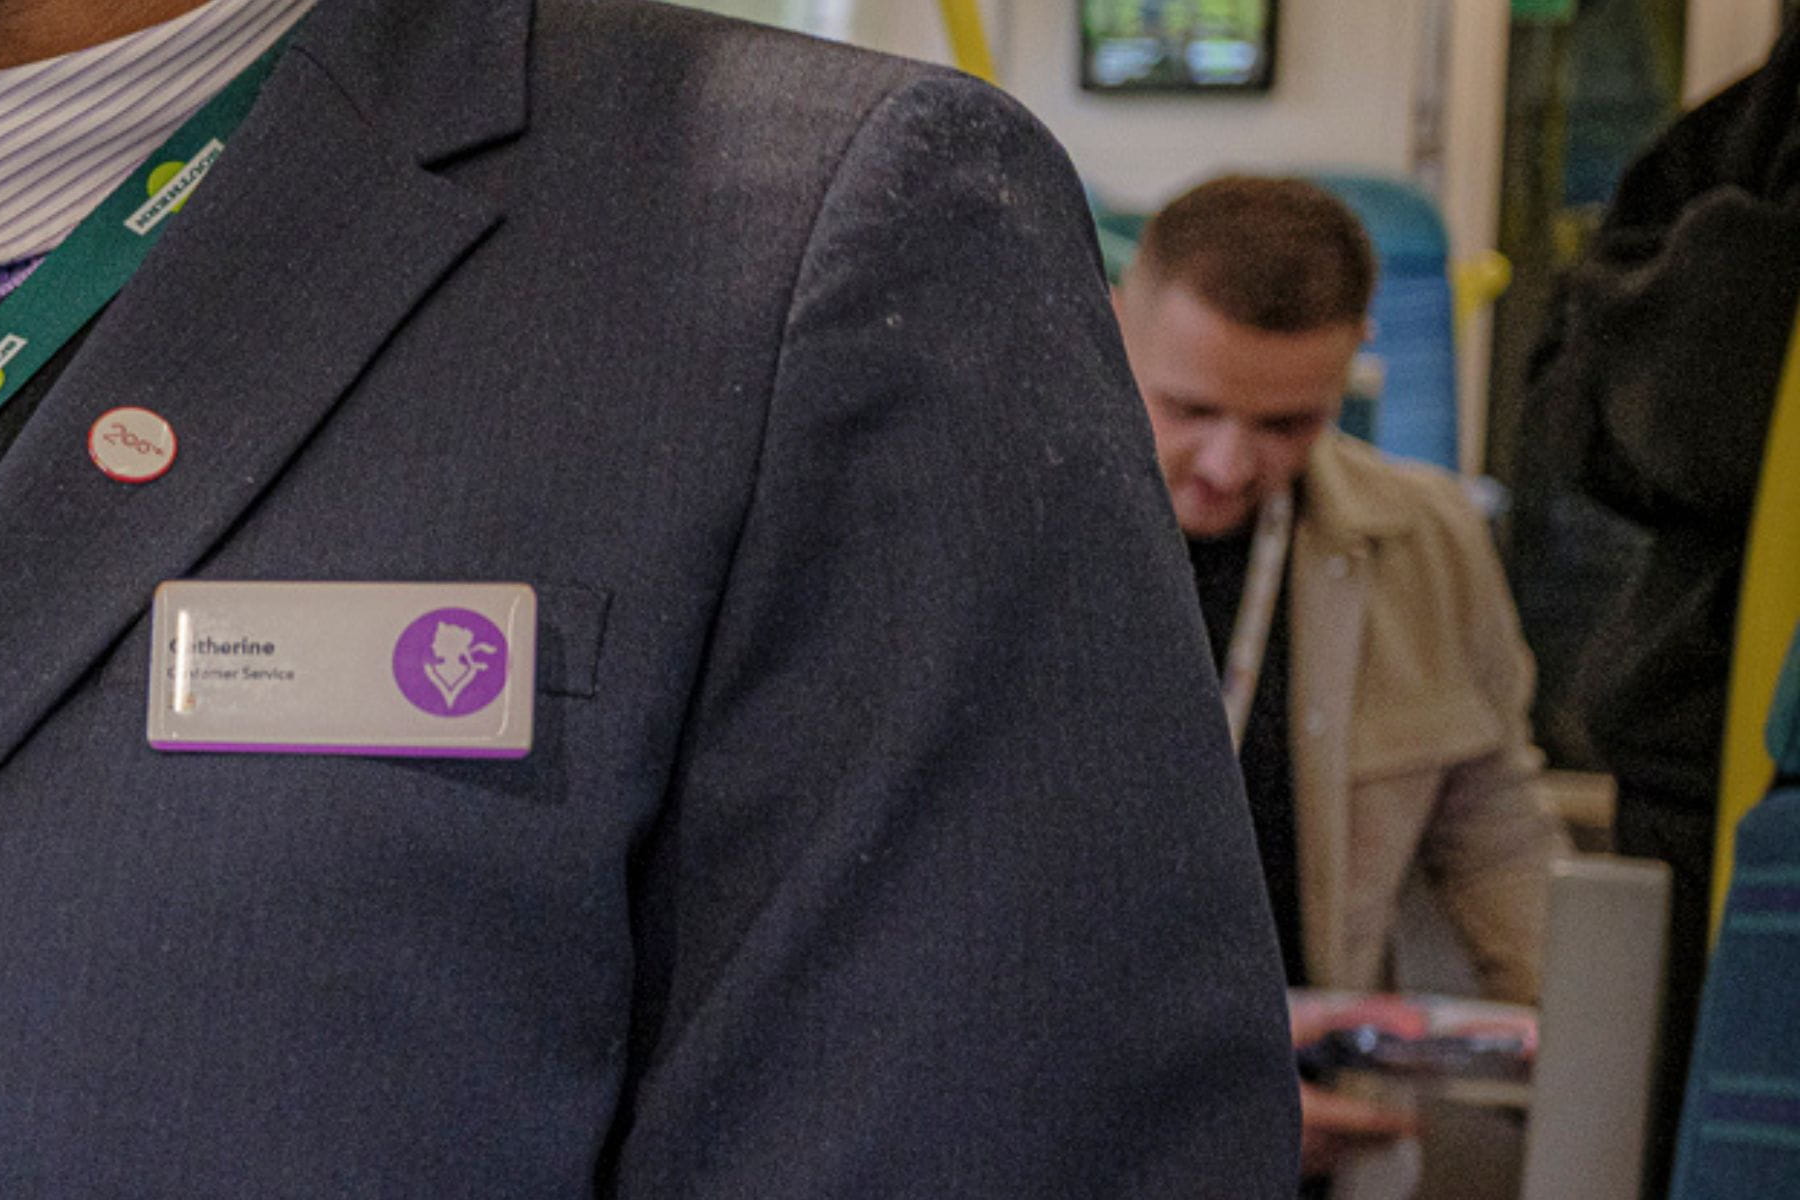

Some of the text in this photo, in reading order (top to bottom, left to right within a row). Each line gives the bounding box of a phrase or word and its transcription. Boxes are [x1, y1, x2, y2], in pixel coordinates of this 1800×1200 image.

[136, 146, 222, 228] SOUTHERN
[168, 636, 275, 655] Ctherine
[166, 666, 294, 680] Cstomer Service
